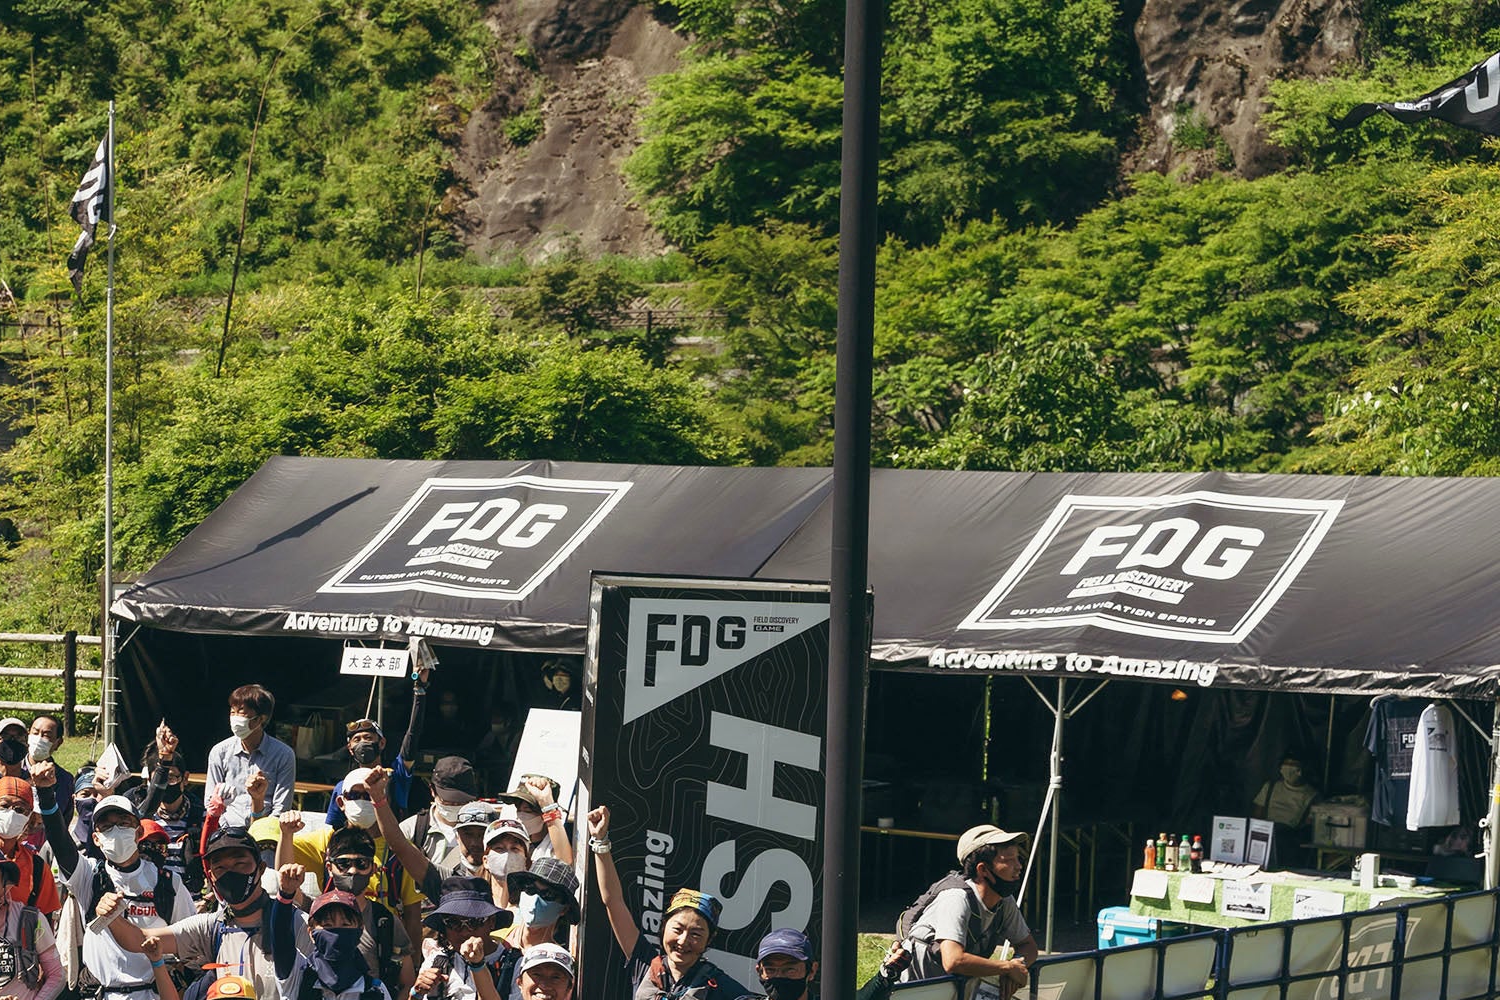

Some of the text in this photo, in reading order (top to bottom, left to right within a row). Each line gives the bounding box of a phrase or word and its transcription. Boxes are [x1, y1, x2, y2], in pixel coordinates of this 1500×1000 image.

[408, 497, 570, 549] FDG
[1060, 517, 1265, 581] FDG
[468, 577, 510, 586] SPORTS
[1114, 568, 1195, 596] DISCOVERY
[283, 610, 495, 647] Adventure to Amazing
[753, 615, 800, 624] FIELD DISCOVERY
[1010, 601, 1216, 628] OUTDOOR NAVIGATION SPORTS
[347, 654, 404, 674] 大会本部
[644, 612, 747, 687] FDG
[928, 648, 1219, 687] Adventure to Amazing
[637, 829, 674, 955] azing
